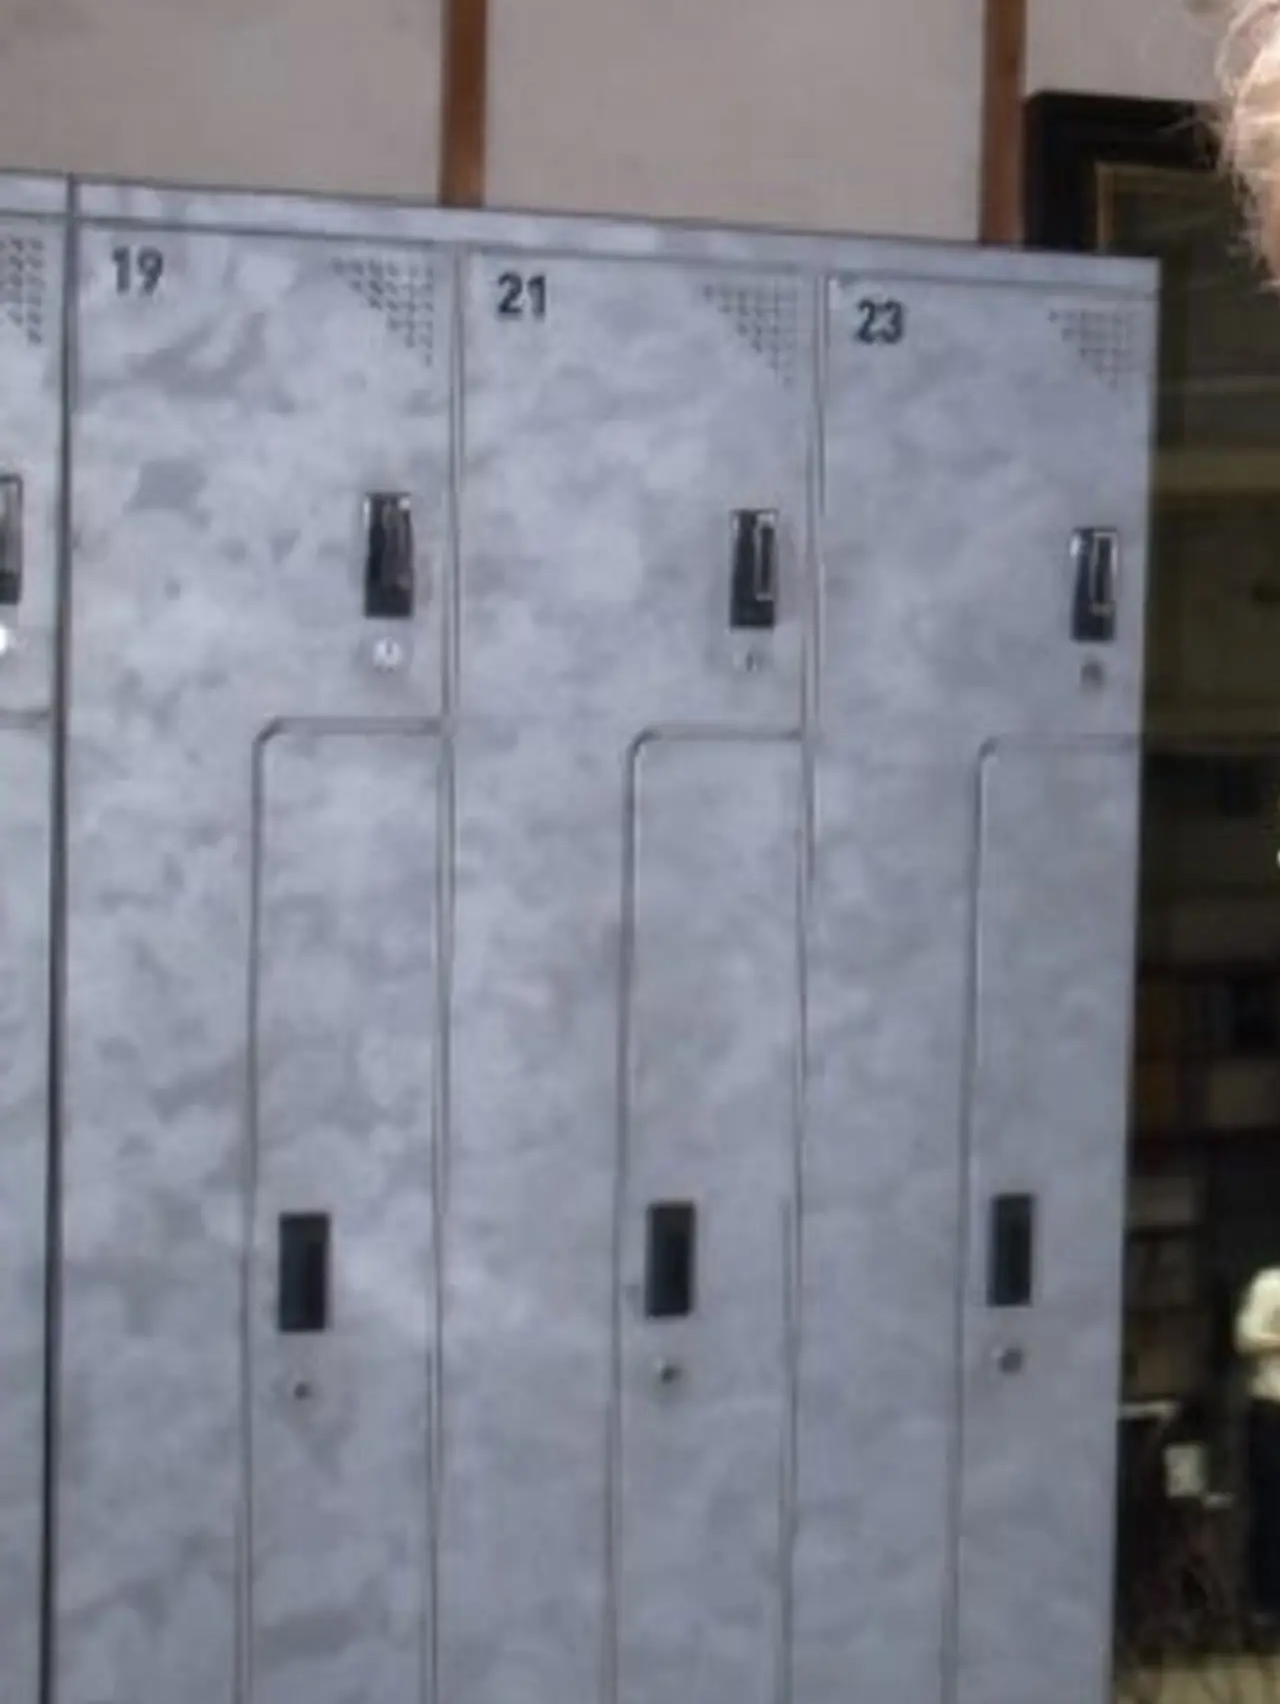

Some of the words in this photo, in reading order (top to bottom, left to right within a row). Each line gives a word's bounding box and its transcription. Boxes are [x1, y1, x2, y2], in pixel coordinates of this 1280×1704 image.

[111, 246, 164, 295] 19
[498, 272, 546, 319] 21
[856, 299, 907, 344] 23
